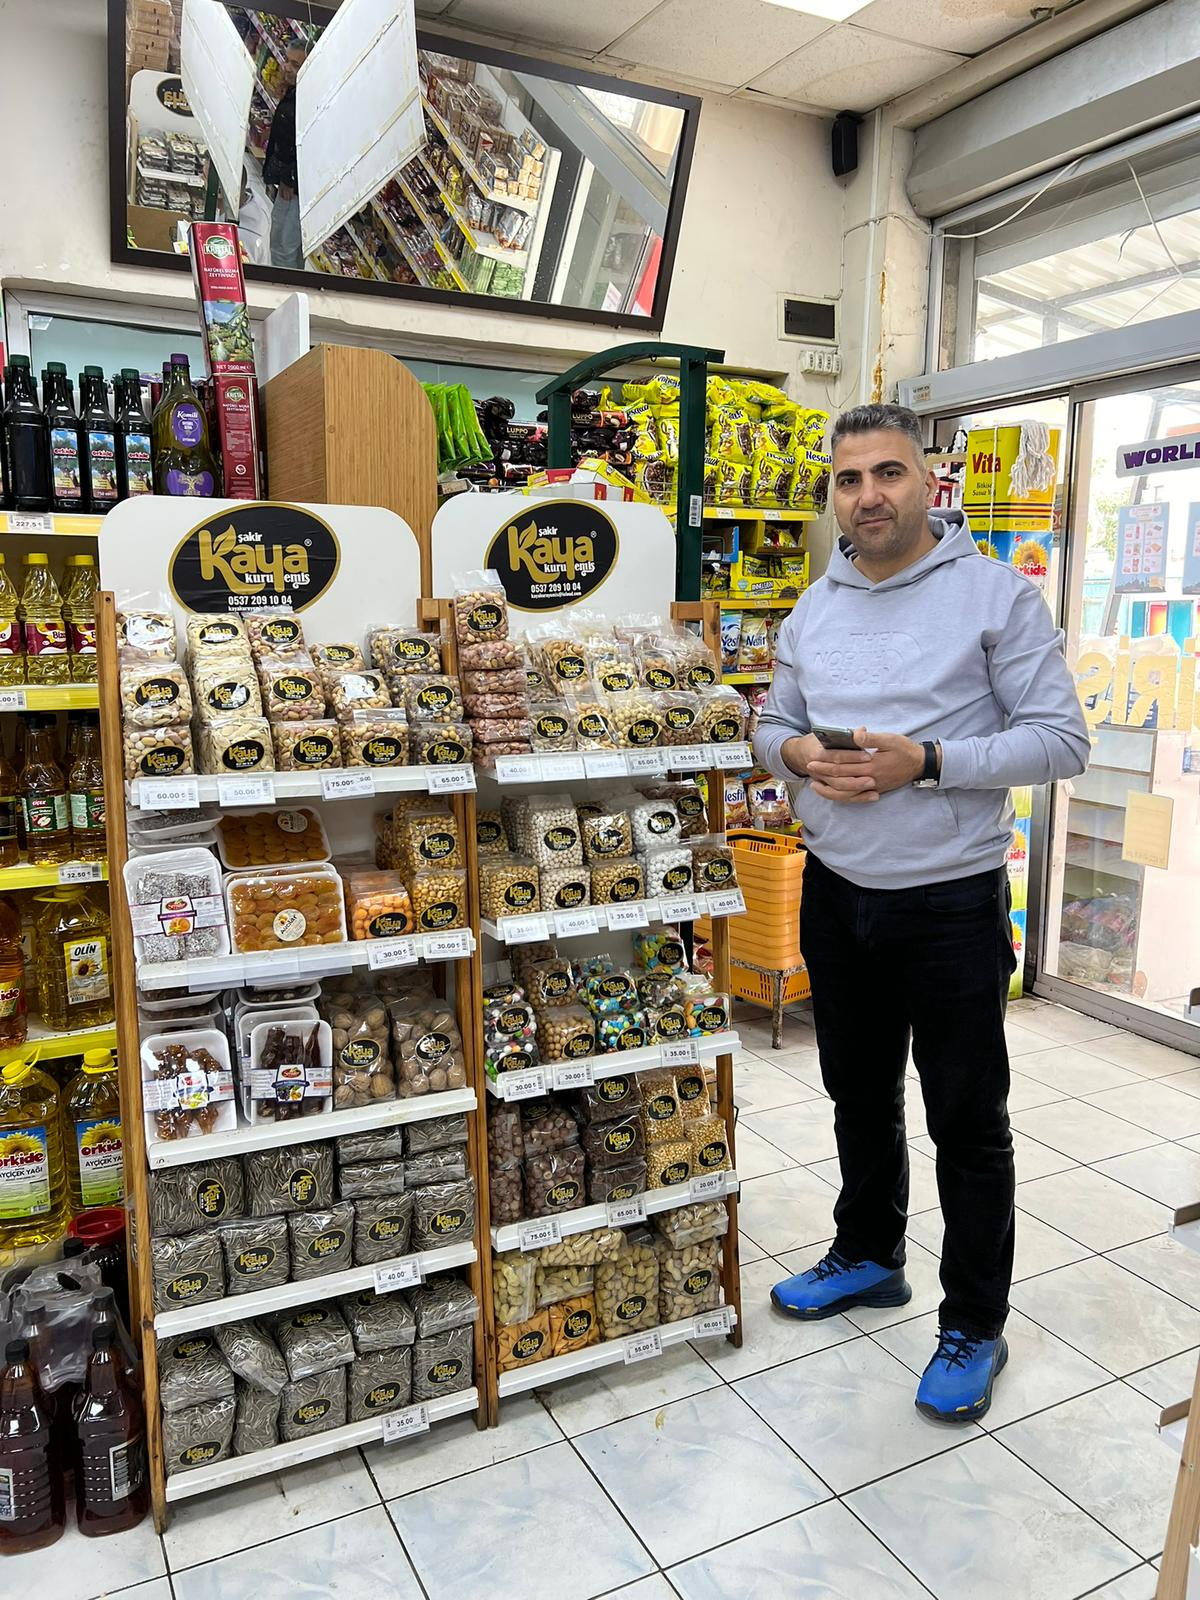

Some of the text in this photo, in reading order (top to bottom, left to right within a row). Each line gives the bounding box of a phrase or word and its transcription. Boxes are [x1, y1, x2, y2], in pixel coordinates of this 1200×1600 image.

[177, 411, 198, 420] Komili
[972, 452, 1001, 474] Vita
[508, 520, 594, 583] Kaya
[199, 524, 309, 595] Kaya
[531, 582, 581, 593] 0537 209 10 04
[228, 595, 293, 605] 0537 209 10 04
[473, 611, 496, 625] Kaya
[266, 625, 292, 638] Kaya
[326, 647, 347, 656] Kaya
[398, 641, 422, 655] Kaya
[560, 659, 578, 674] Kaya
[607, 676, 627, 688] Kaya
[650, 671, 670, 684] Kaya
[140, 683, 171, 698] Kaya
[279, 679, 305, 694] Kaya
[422, 691, 447, 704] Kaya
[668, 710, 688, 724] Kaya
[541, 720, 561, 731] Kaya
[580, 718, 601, 732] Kaya
[713, 723, 733, 737] Kaya
[632, 724, 653, 739] Kaya
[230, 747, 256, 763] Kaya
[300, 742, 326, 757] Kaya
[369, 743, 395, 758] Kaya
[434, 744, 456, 760] Kaya
[146, 753, 176, 768] Kaya
[331, 780, 351, 788] 75.00
[441, 776, 460, 784] 65.00
[425, 840, 449, 853] Kaya
[709, 865, 726, 875] Kaya
[668, 872, 687, 884] Kaya
[510, 886, 531, 899] Kaya
[561, 889, 580, 901] Kaya
[613, 883, 634, 895] Kaya
[427, 909, 452, 922] Kaya
[376, 919, 402, 931] Kaya
[74, 944, 97, 956] OLİN
[437, 942, 455, 950] 30.00
[383, 950, 402, 958] 30.00
[548, 979, 565, 989] Kaya
[603, 983, 623, 993] Kaya
[501, 1016, 523, 1026] Kaya
[701, 1012, 720, 1022] Kaya
[659, 1018, 678, 1031] Kaya
[570, 1039, 589, 1052] Kaya
[621, 1035, 641, 1047] Kaya
[564, 1072, 581, 1080] 30.00
[515, 1083, 532, 1091] 30.00
[604, 1082, 624, 1095] Kaya
[652, 1103, 672, 1112] Kaya
[609, 1133, 630, 1145] Kaya
[704, 1148, 723, 1160] Kaya
[85, 1157, 112, 1168] AYÇİÇEK
[26, 1166, 43, 1175] YAĞI
[666, 1168, 685, 1180] Kaya
[553, 1188, 573, 1200] Kaya
[436, 1215, 458, 1229] Kaya
[376, 1223, 397, 1235] Kaya
[530, 1231, 547, 1240] 75.00
[315, 1240, 339, 1252] Kaya
[240, 1254, 267, 1267] Kaya
[387, 1271, 404, 1280] 40.00
[173, 1281, 200, 1294] Kaya
[688, 1276, 707, 1289] Kaya
[621, 1301, 641, 1313] Kaya
[568, 1320, 587, 1333] Kaya
[518, 1339, 539, 1352] Kaya
[434, 1367, 456, 1376] Kaya
[371, 1391, 394, 1400] Kaya
[299, 1408, 322, 1417] Kaya
[187, 1448, 212, 1461] Kaya
